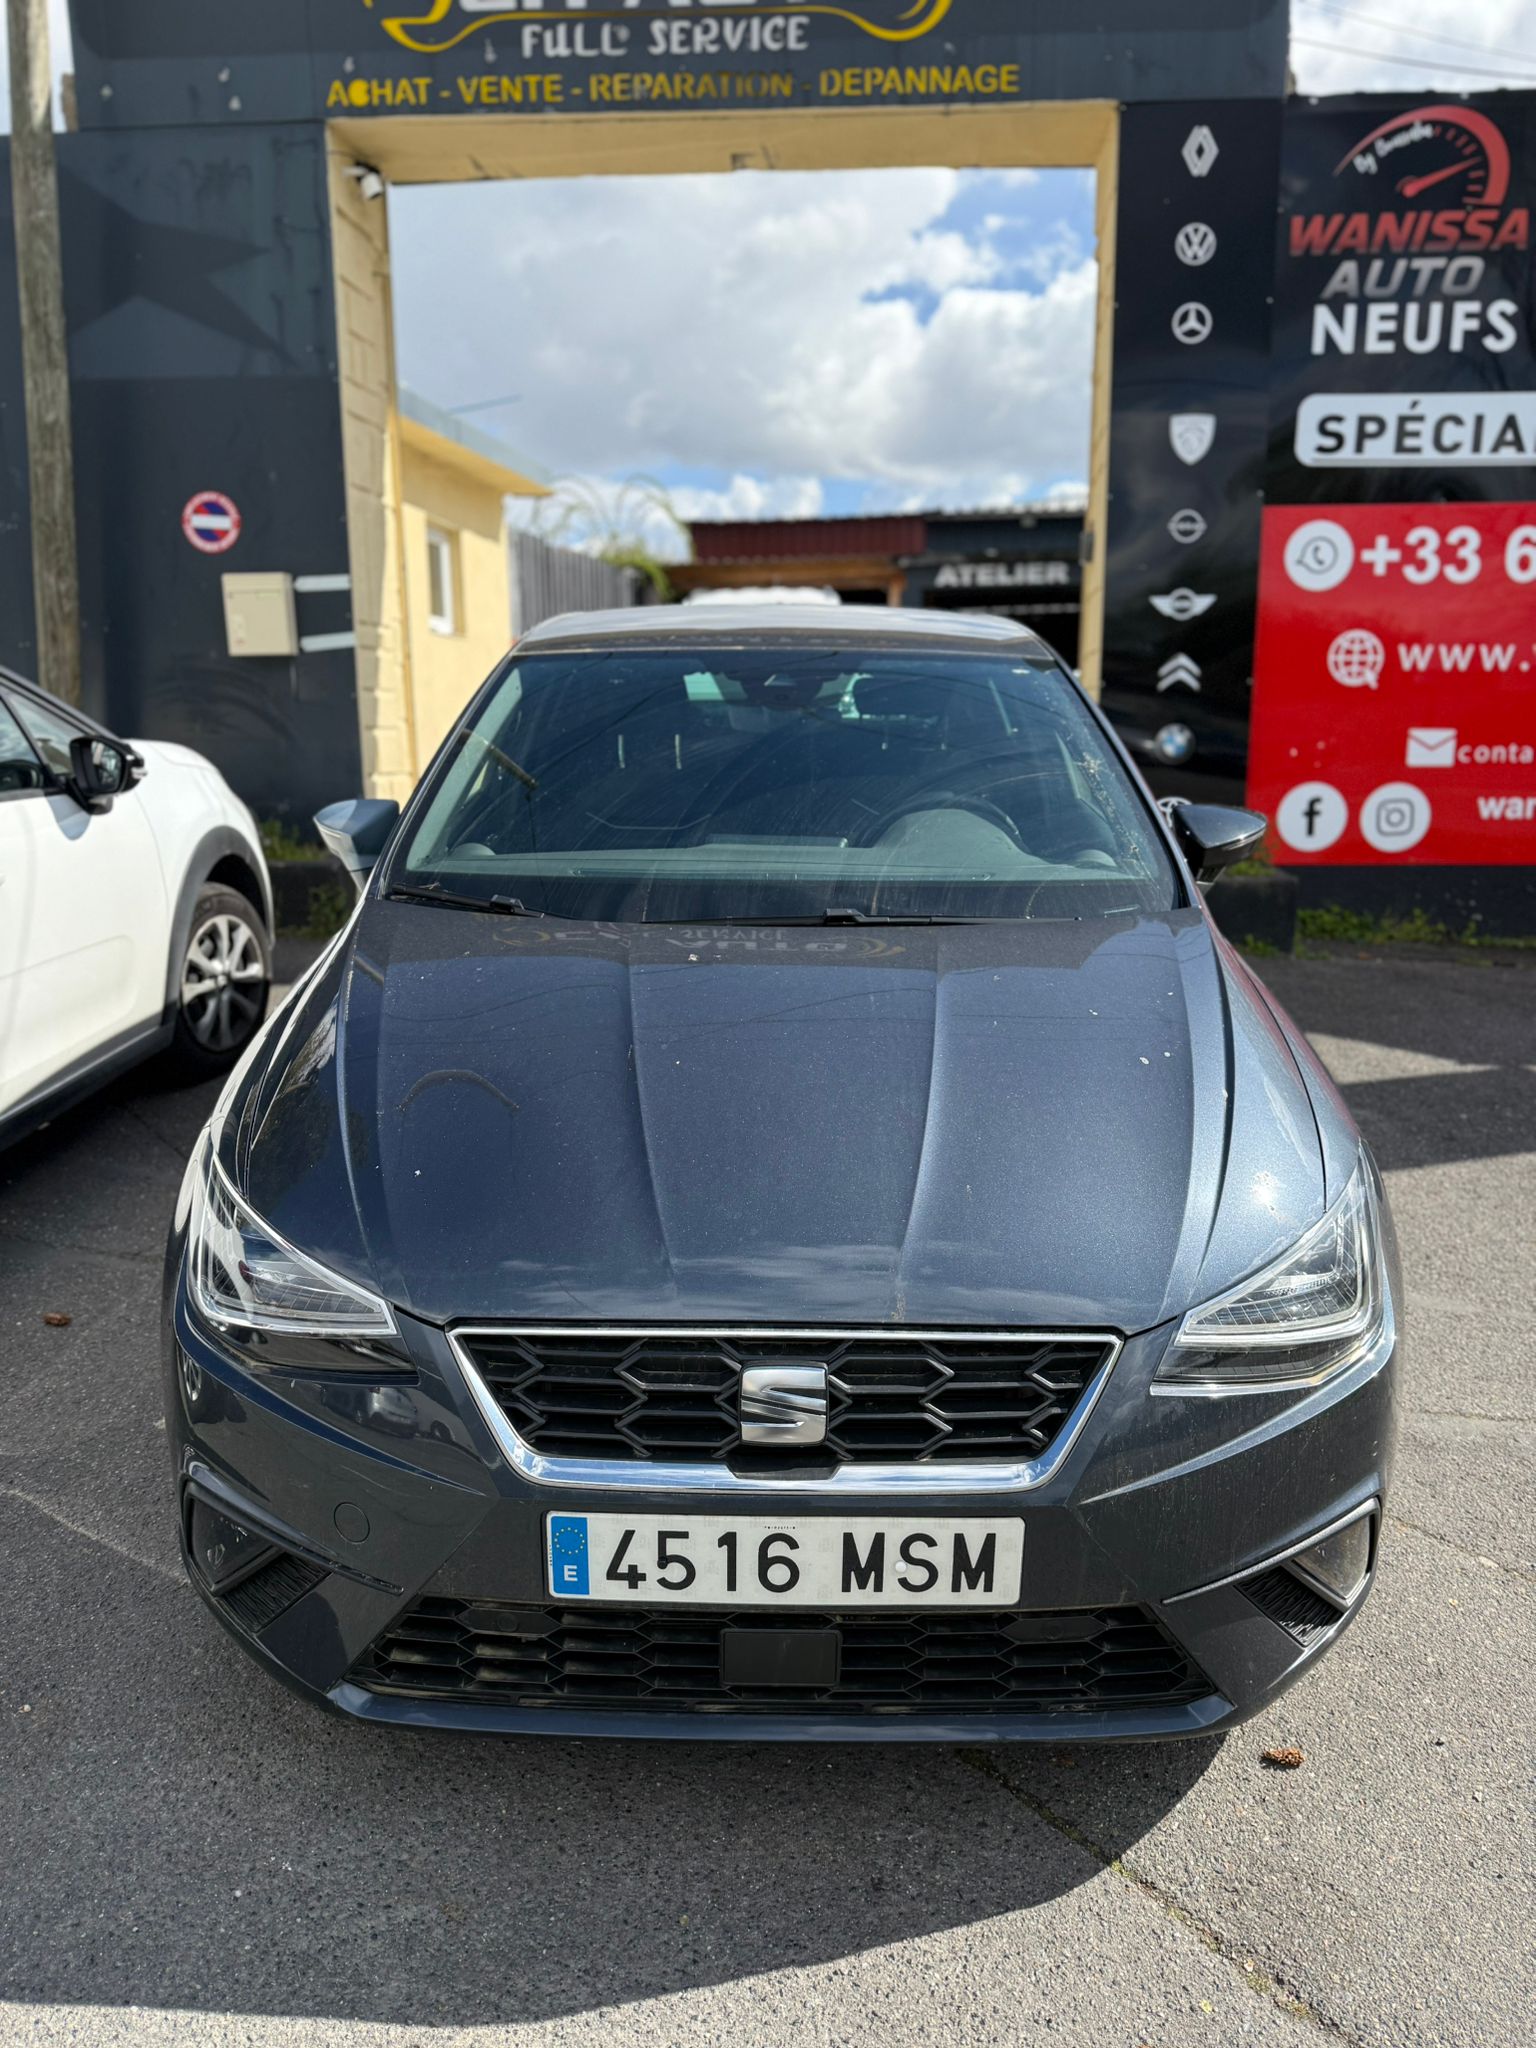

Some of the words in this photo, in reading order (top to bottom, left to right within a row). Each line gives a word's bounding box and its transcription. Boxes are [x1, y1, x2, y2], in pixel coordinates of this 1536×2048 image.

[648, 16, 810, 55] SERVICE
[457, 73, 564, 104] VENTE
[589, 70, 793, 101] REPARATION
[819, 64, 1020, 96] DEPANNAGE
[1290, 207, 1529, 256] WANISSA
[1319, 255, 1485, 299] AUTO
[1311, 299, 1518, 355] NEUFS
[1315, 400, 1536, 454] SPÉCIA
[934, 561, 1070, 587] ATELIER
[1360, 525, 1482, 585] +33
[1504, 524, 1536, 585] 6
[1397, 643, 1536, 673] www.
[1457, 742, 1535, 764] conta
[563, 1564, 579, 1582] E
[606, 1529, 801, 1593] 4516
[841, 1532, 997, 1593] MSM
